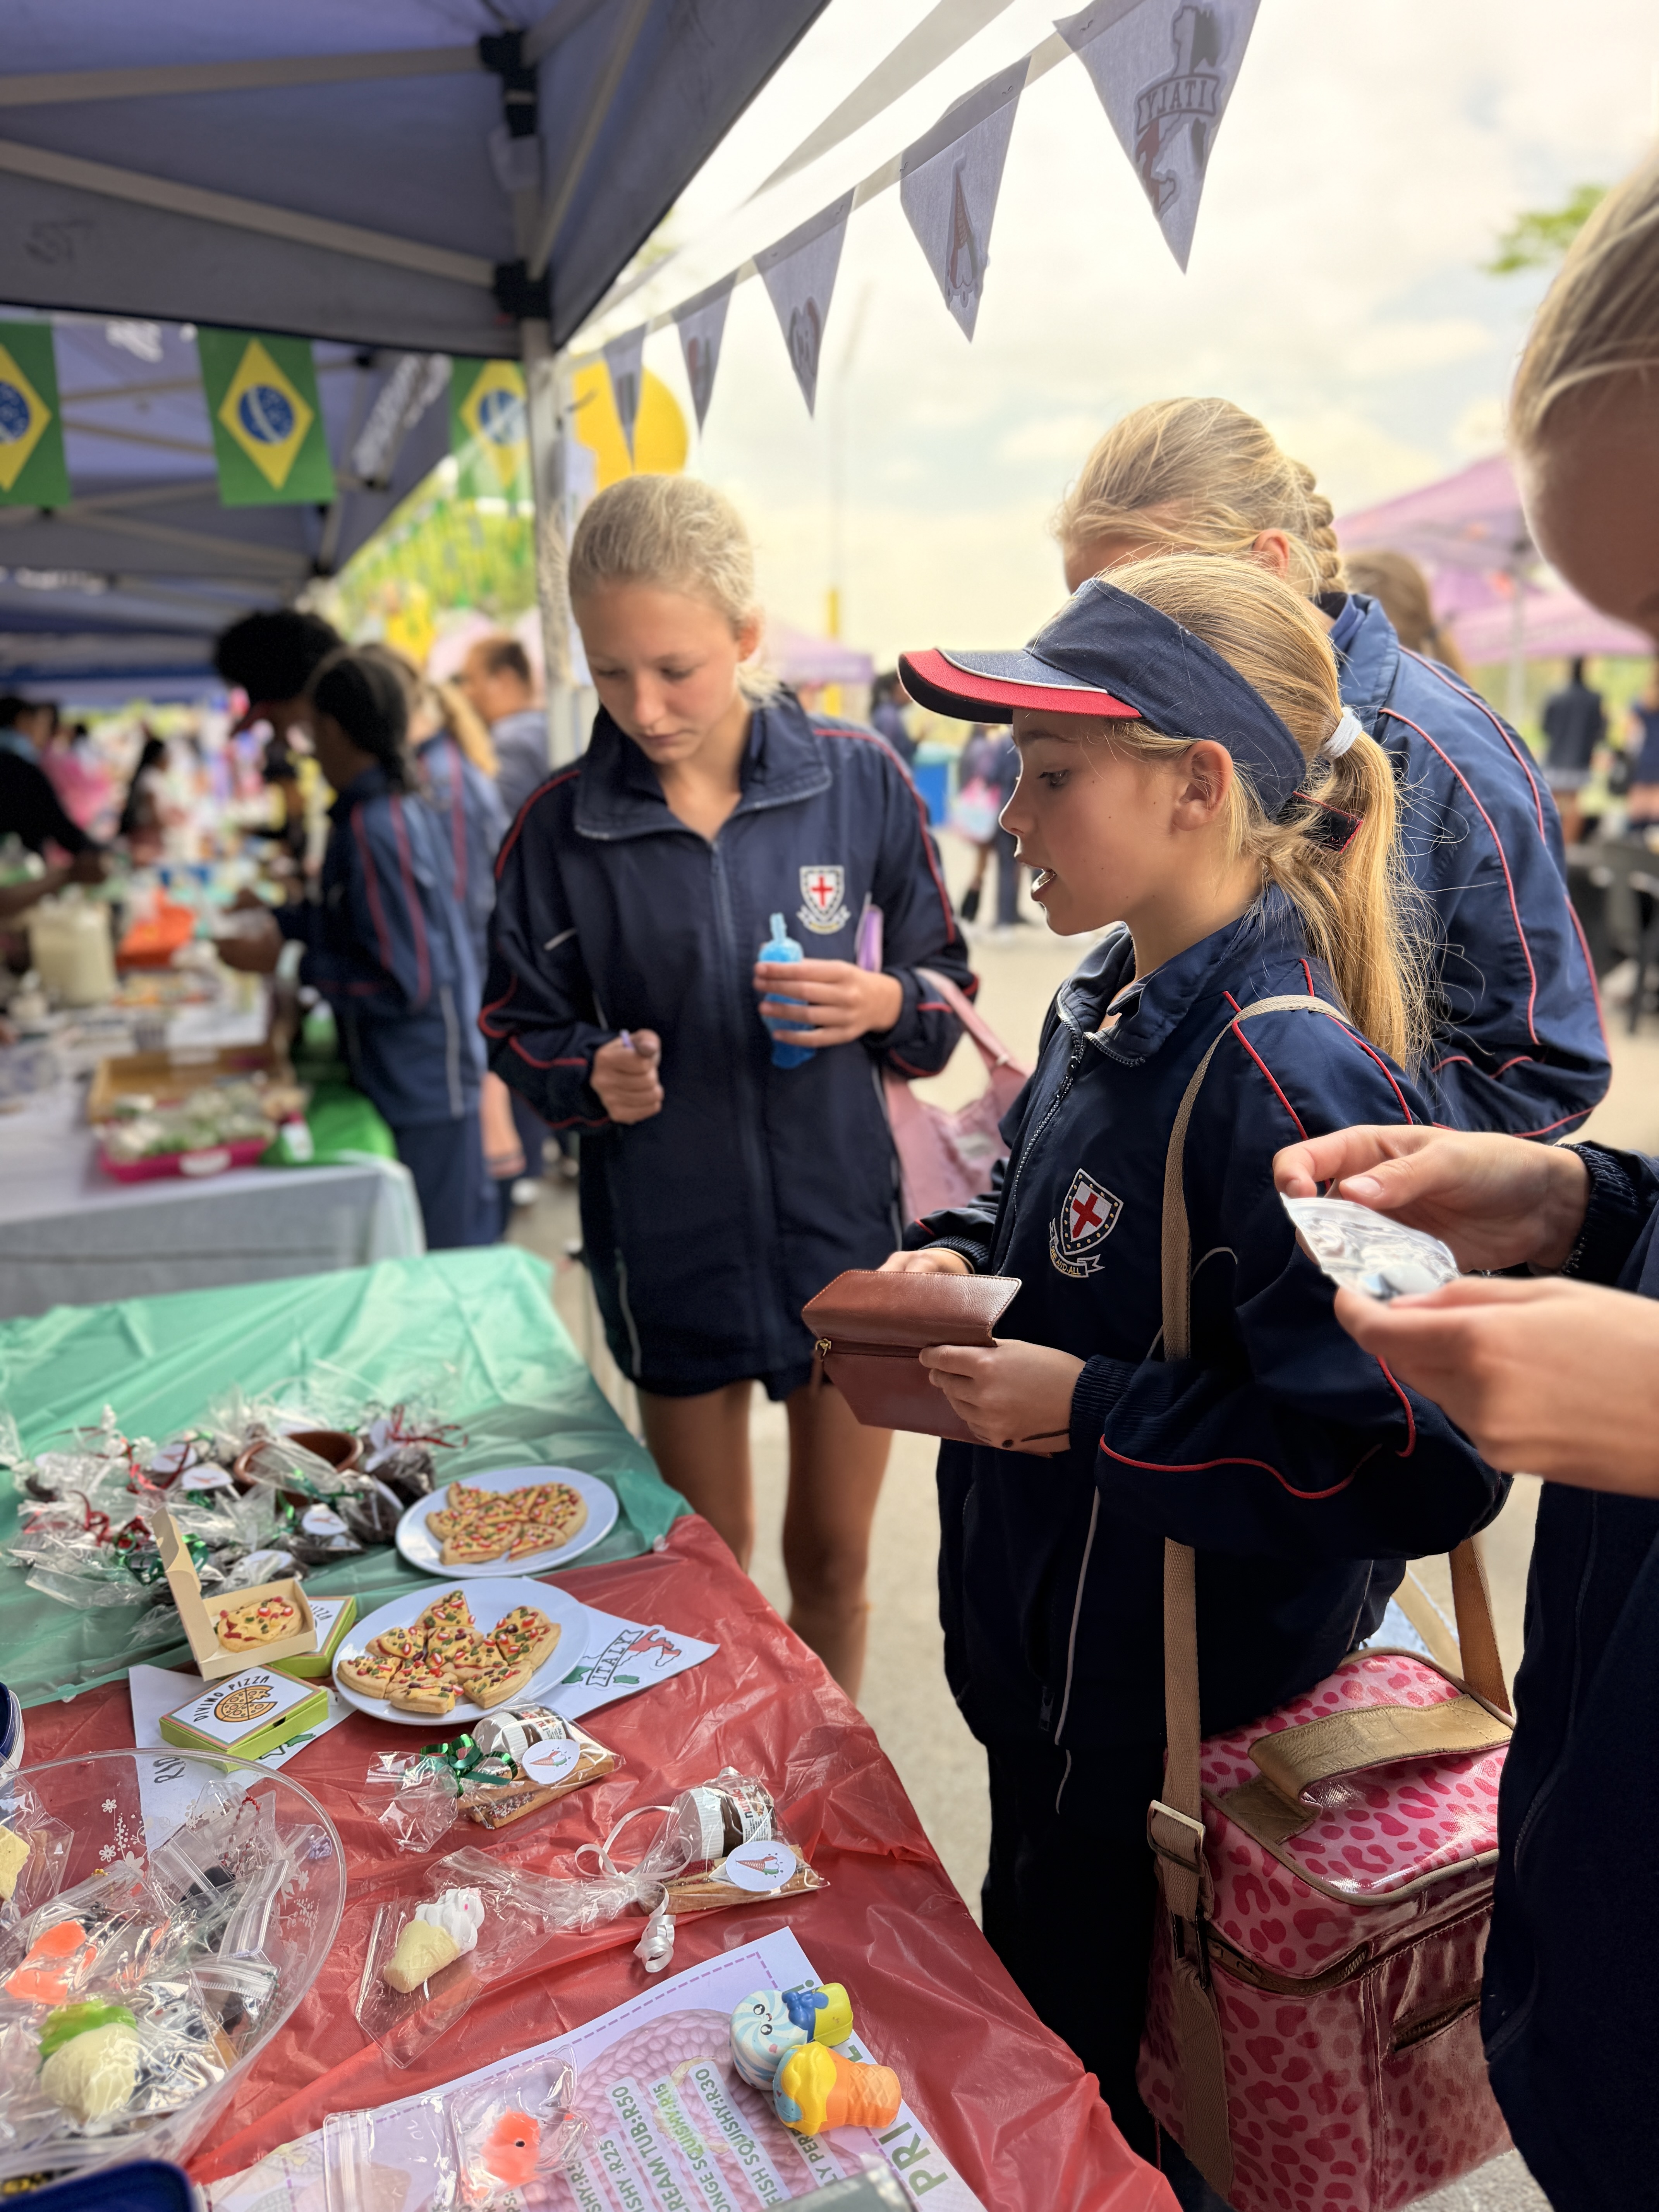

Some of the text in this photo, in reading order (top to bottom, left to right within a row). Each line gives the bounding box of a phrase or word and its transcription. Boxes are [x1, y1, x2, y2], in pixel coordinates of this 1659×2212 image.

[1056, 1258, 1068, 1271] AND
[1068, 1266, 1081, 1275] ALL
[592, 1637, 633, 1681] ITALY
[193, 1675, 271, 1722] DIVINO PIZZA
[731, 1788, 754, 1819] nutella
[612, 2086, 659, 2159] TUB:R50
[878, 2121, 949, 2197] PRI
